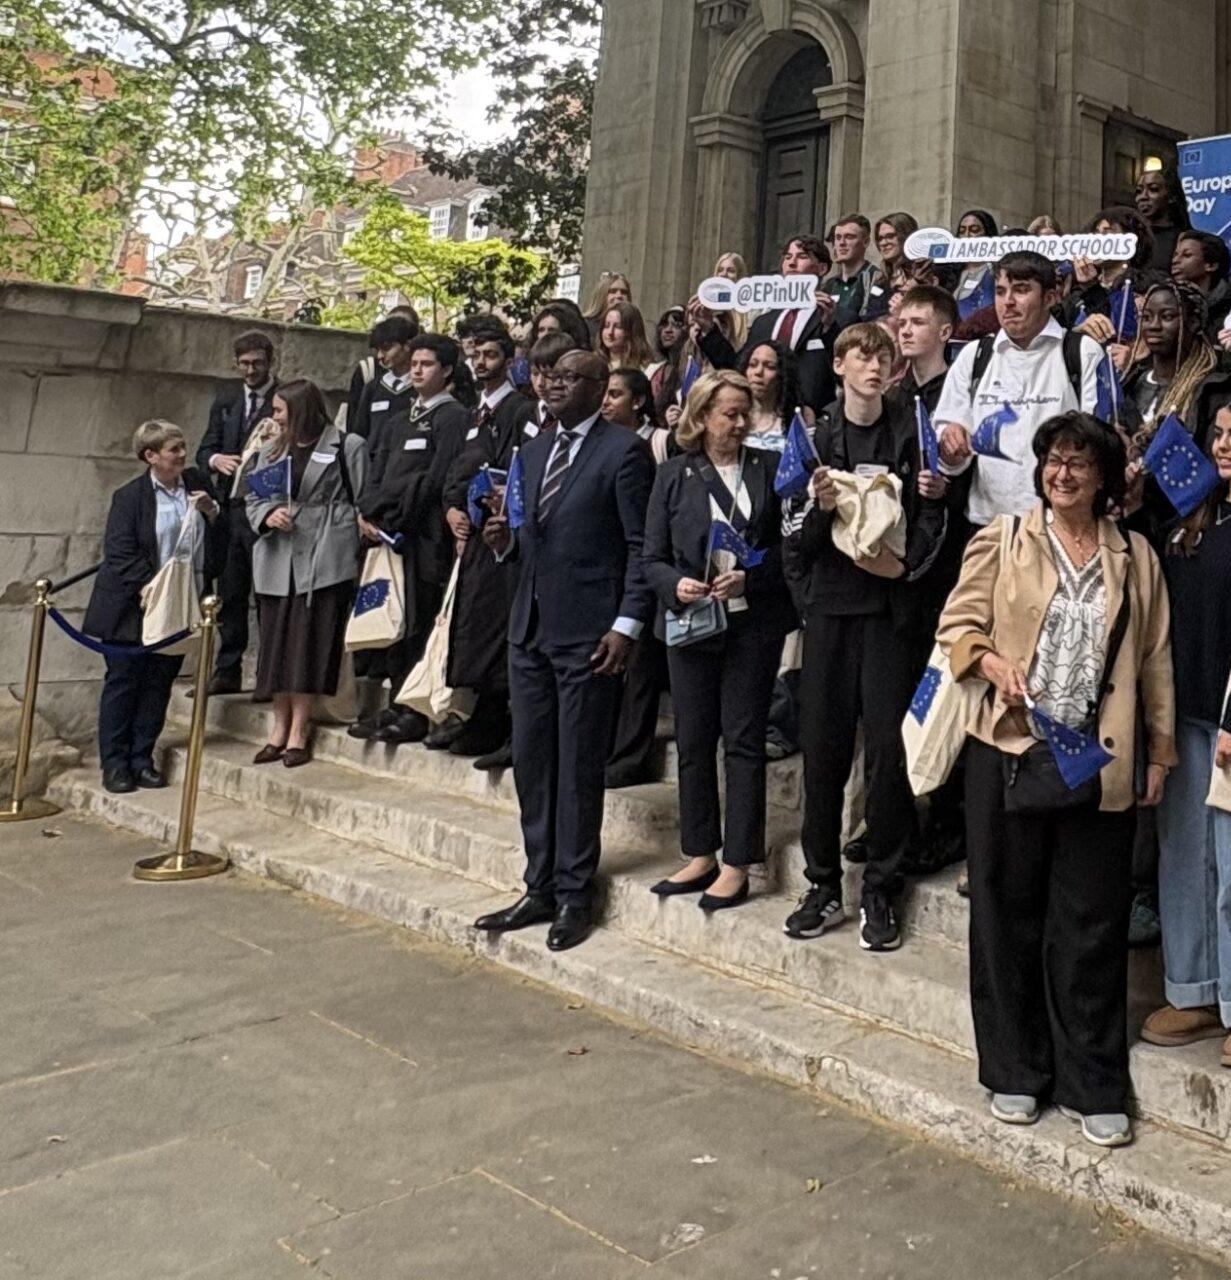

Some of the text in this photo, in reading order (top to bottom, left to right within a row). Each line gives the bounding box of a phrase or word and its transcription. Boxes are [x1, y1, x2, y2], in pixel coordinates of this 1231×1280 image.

[956, 238, 1133, 258] AMBASSADOR SCHOOLS
[737, 281, 812, 306] @EPinUK
